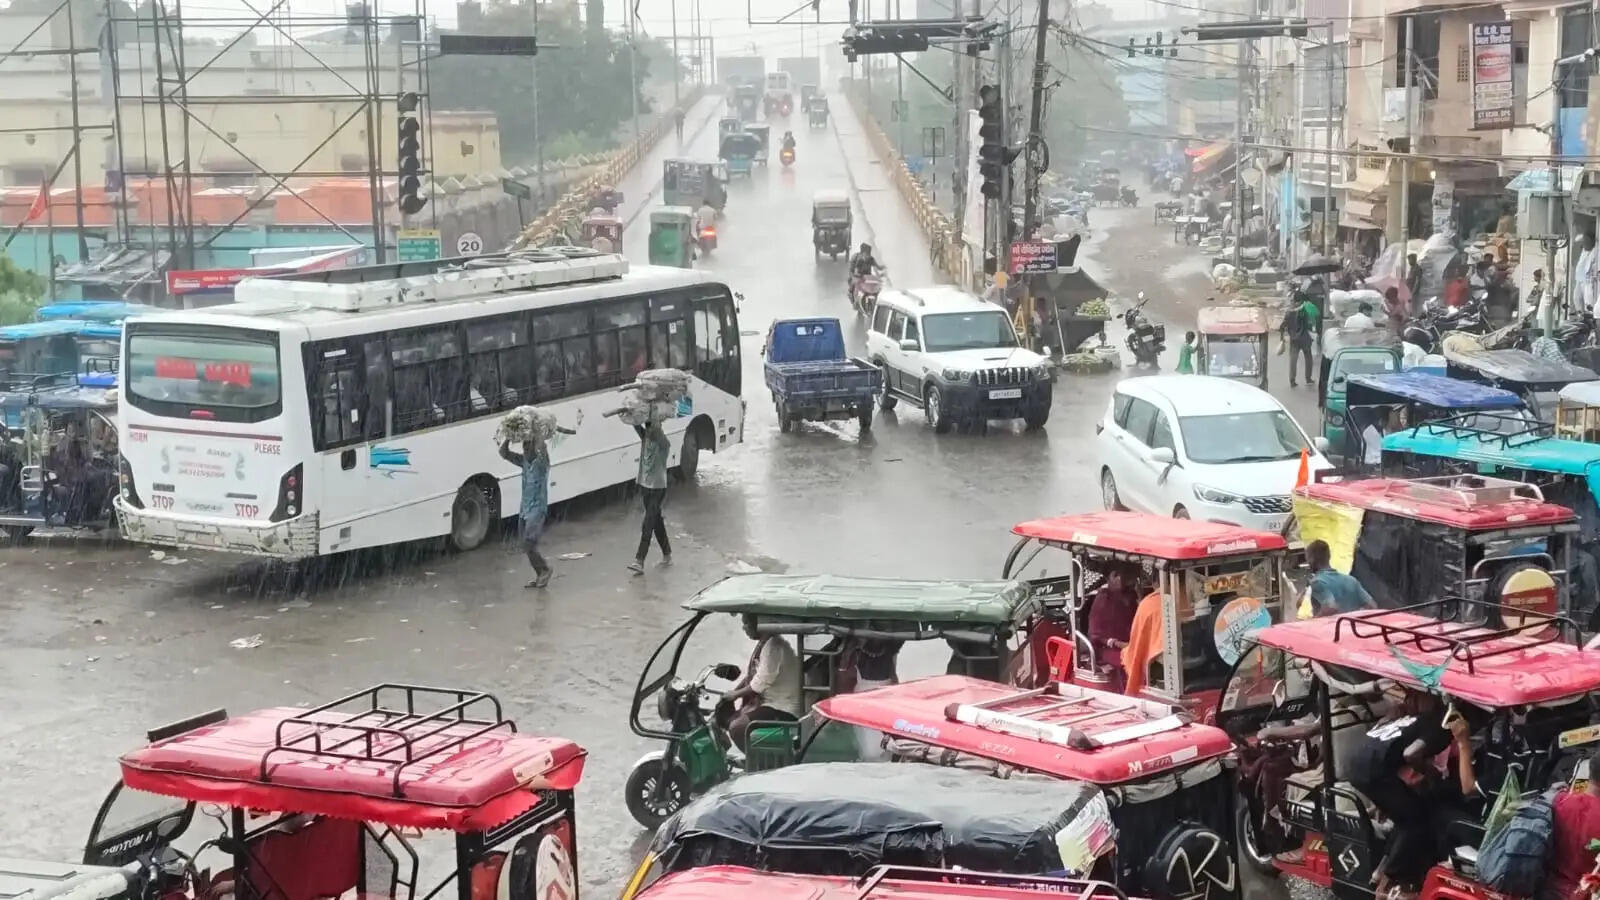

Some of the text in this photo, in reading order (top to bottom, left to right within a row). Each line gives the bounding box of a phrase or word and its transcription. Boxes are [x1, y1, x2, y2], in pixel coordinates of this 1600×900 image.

[461, 240, 480, 252] 20
[254, 442, 281, 455] PLEASE
[152, 495, 175, 511] STOP
[234, 503, 259, 518] STOP
